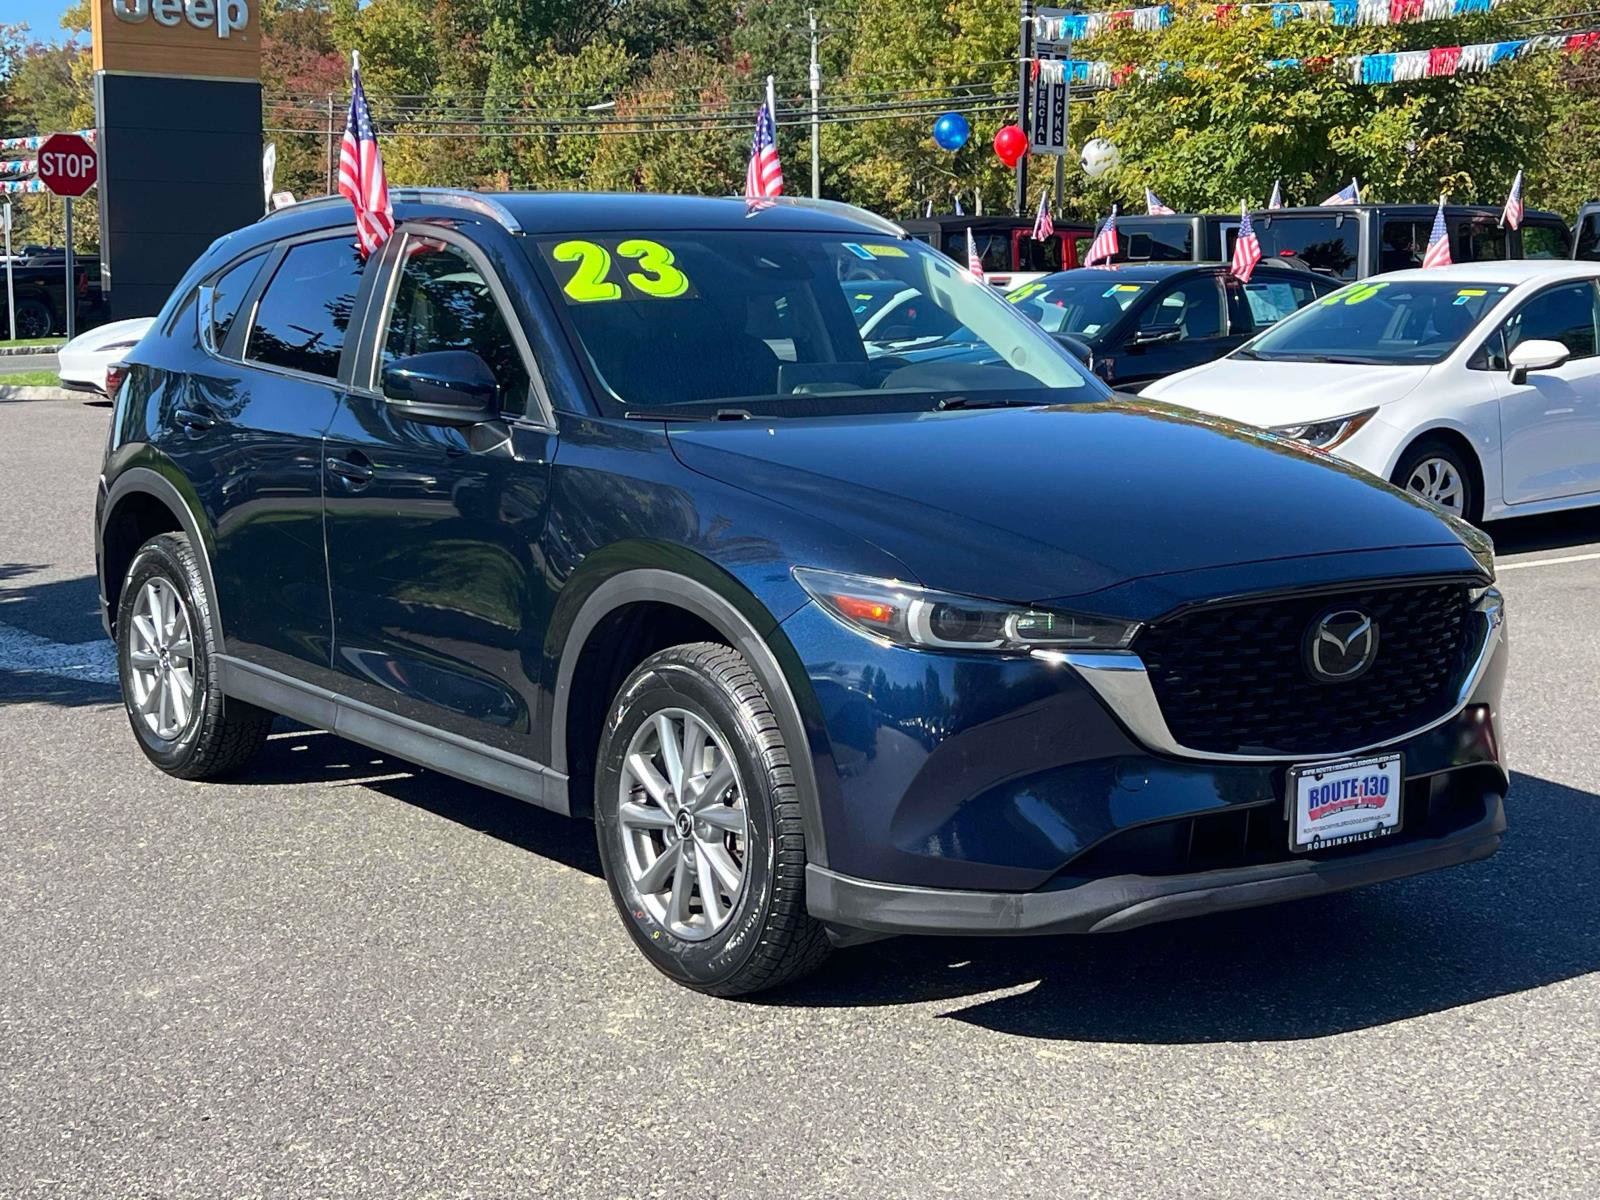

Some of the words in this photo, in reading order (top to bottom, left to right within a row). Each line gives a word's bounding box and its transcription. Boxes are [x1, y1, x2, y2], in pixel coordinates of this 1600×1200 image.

[41, 152, 95, 178] STOP
[552, 240, 689, 302] 23
[1321, 282, 1390, 305] 26
[1309, 778, 1359, 809] ROUTE
[1363, 776, 1389, 796] 130
[1380, 827, 1392, 836] NJ
